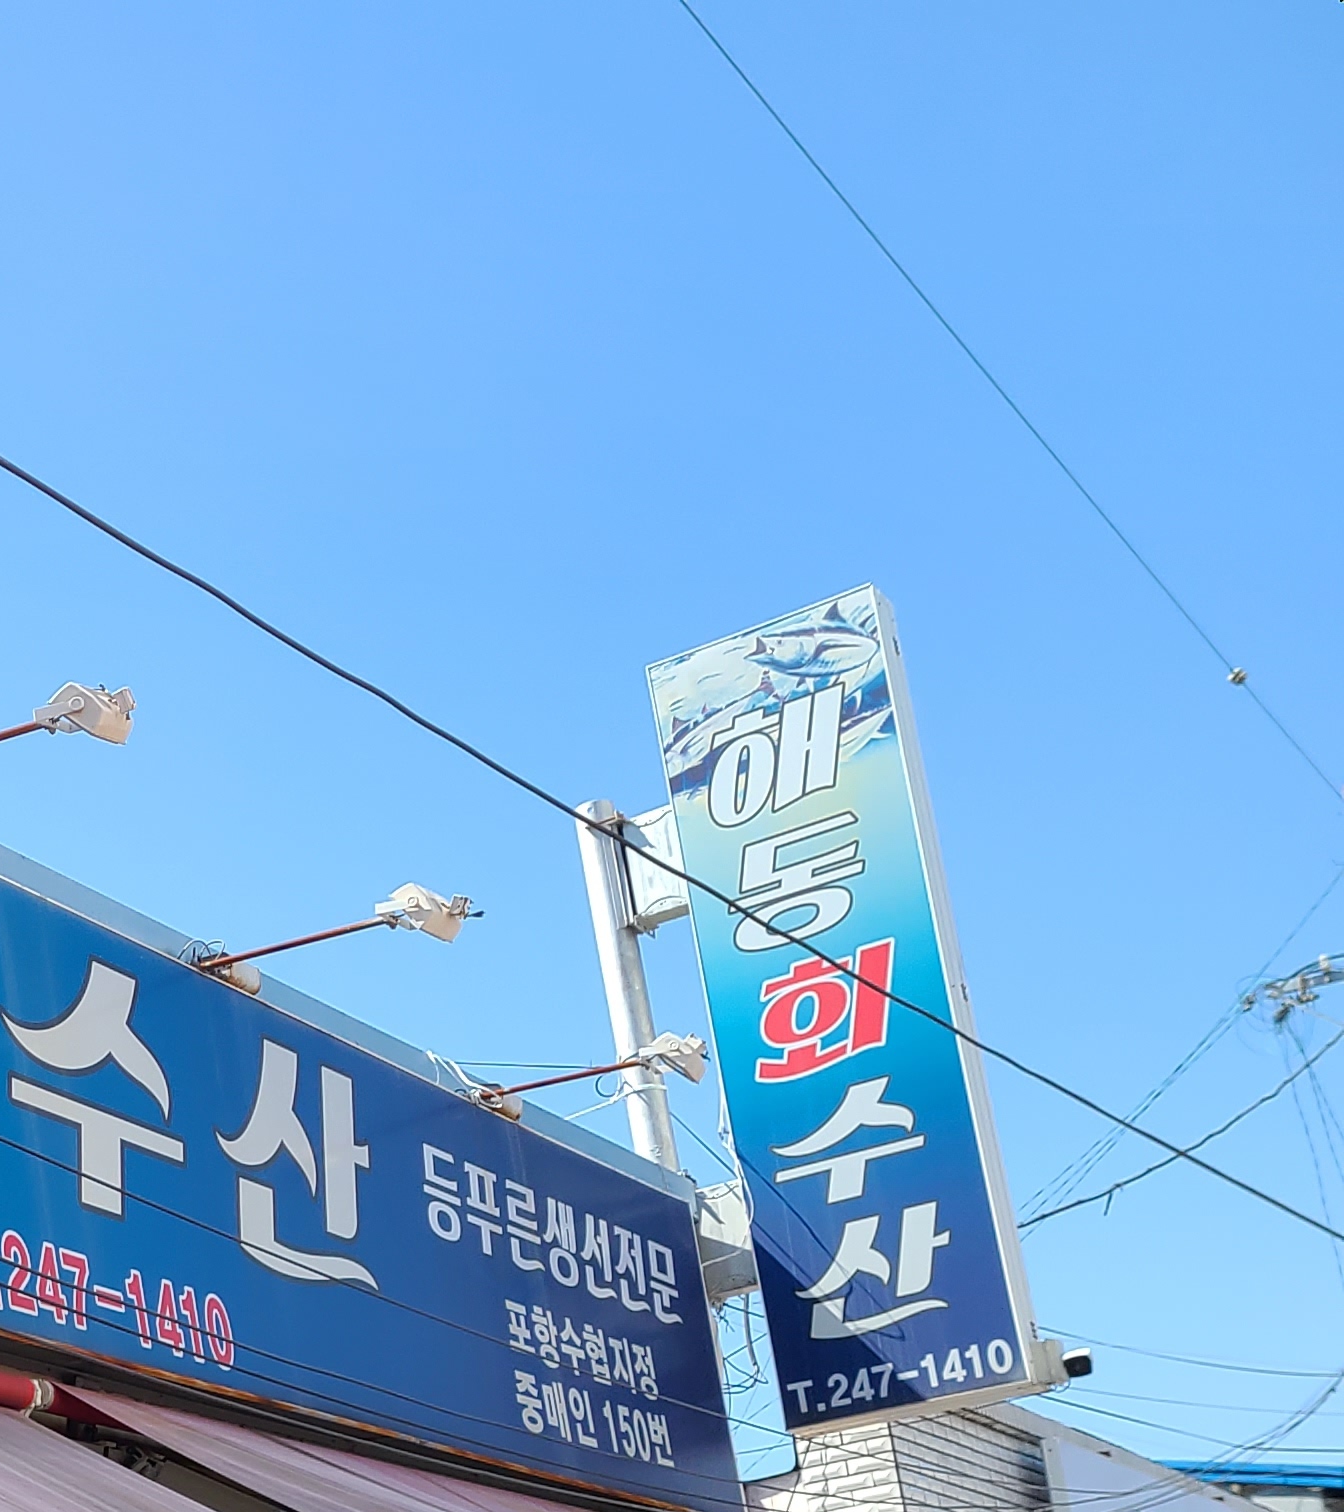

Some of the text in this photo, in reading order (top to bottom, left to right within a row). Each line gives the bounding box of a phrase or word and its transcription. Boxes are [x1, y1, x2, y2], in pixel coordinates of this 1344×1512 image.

[708, 682, 950, 1340] 해동회수산
[422, 1142, 683, 1324] 등푸른생선전문
[505, 1299, 658, 1401] 포항수협지정
[787, 1337, 1014, 1415] T.247-1410
[514, 1370, 676, 1468] 중매인 150번
